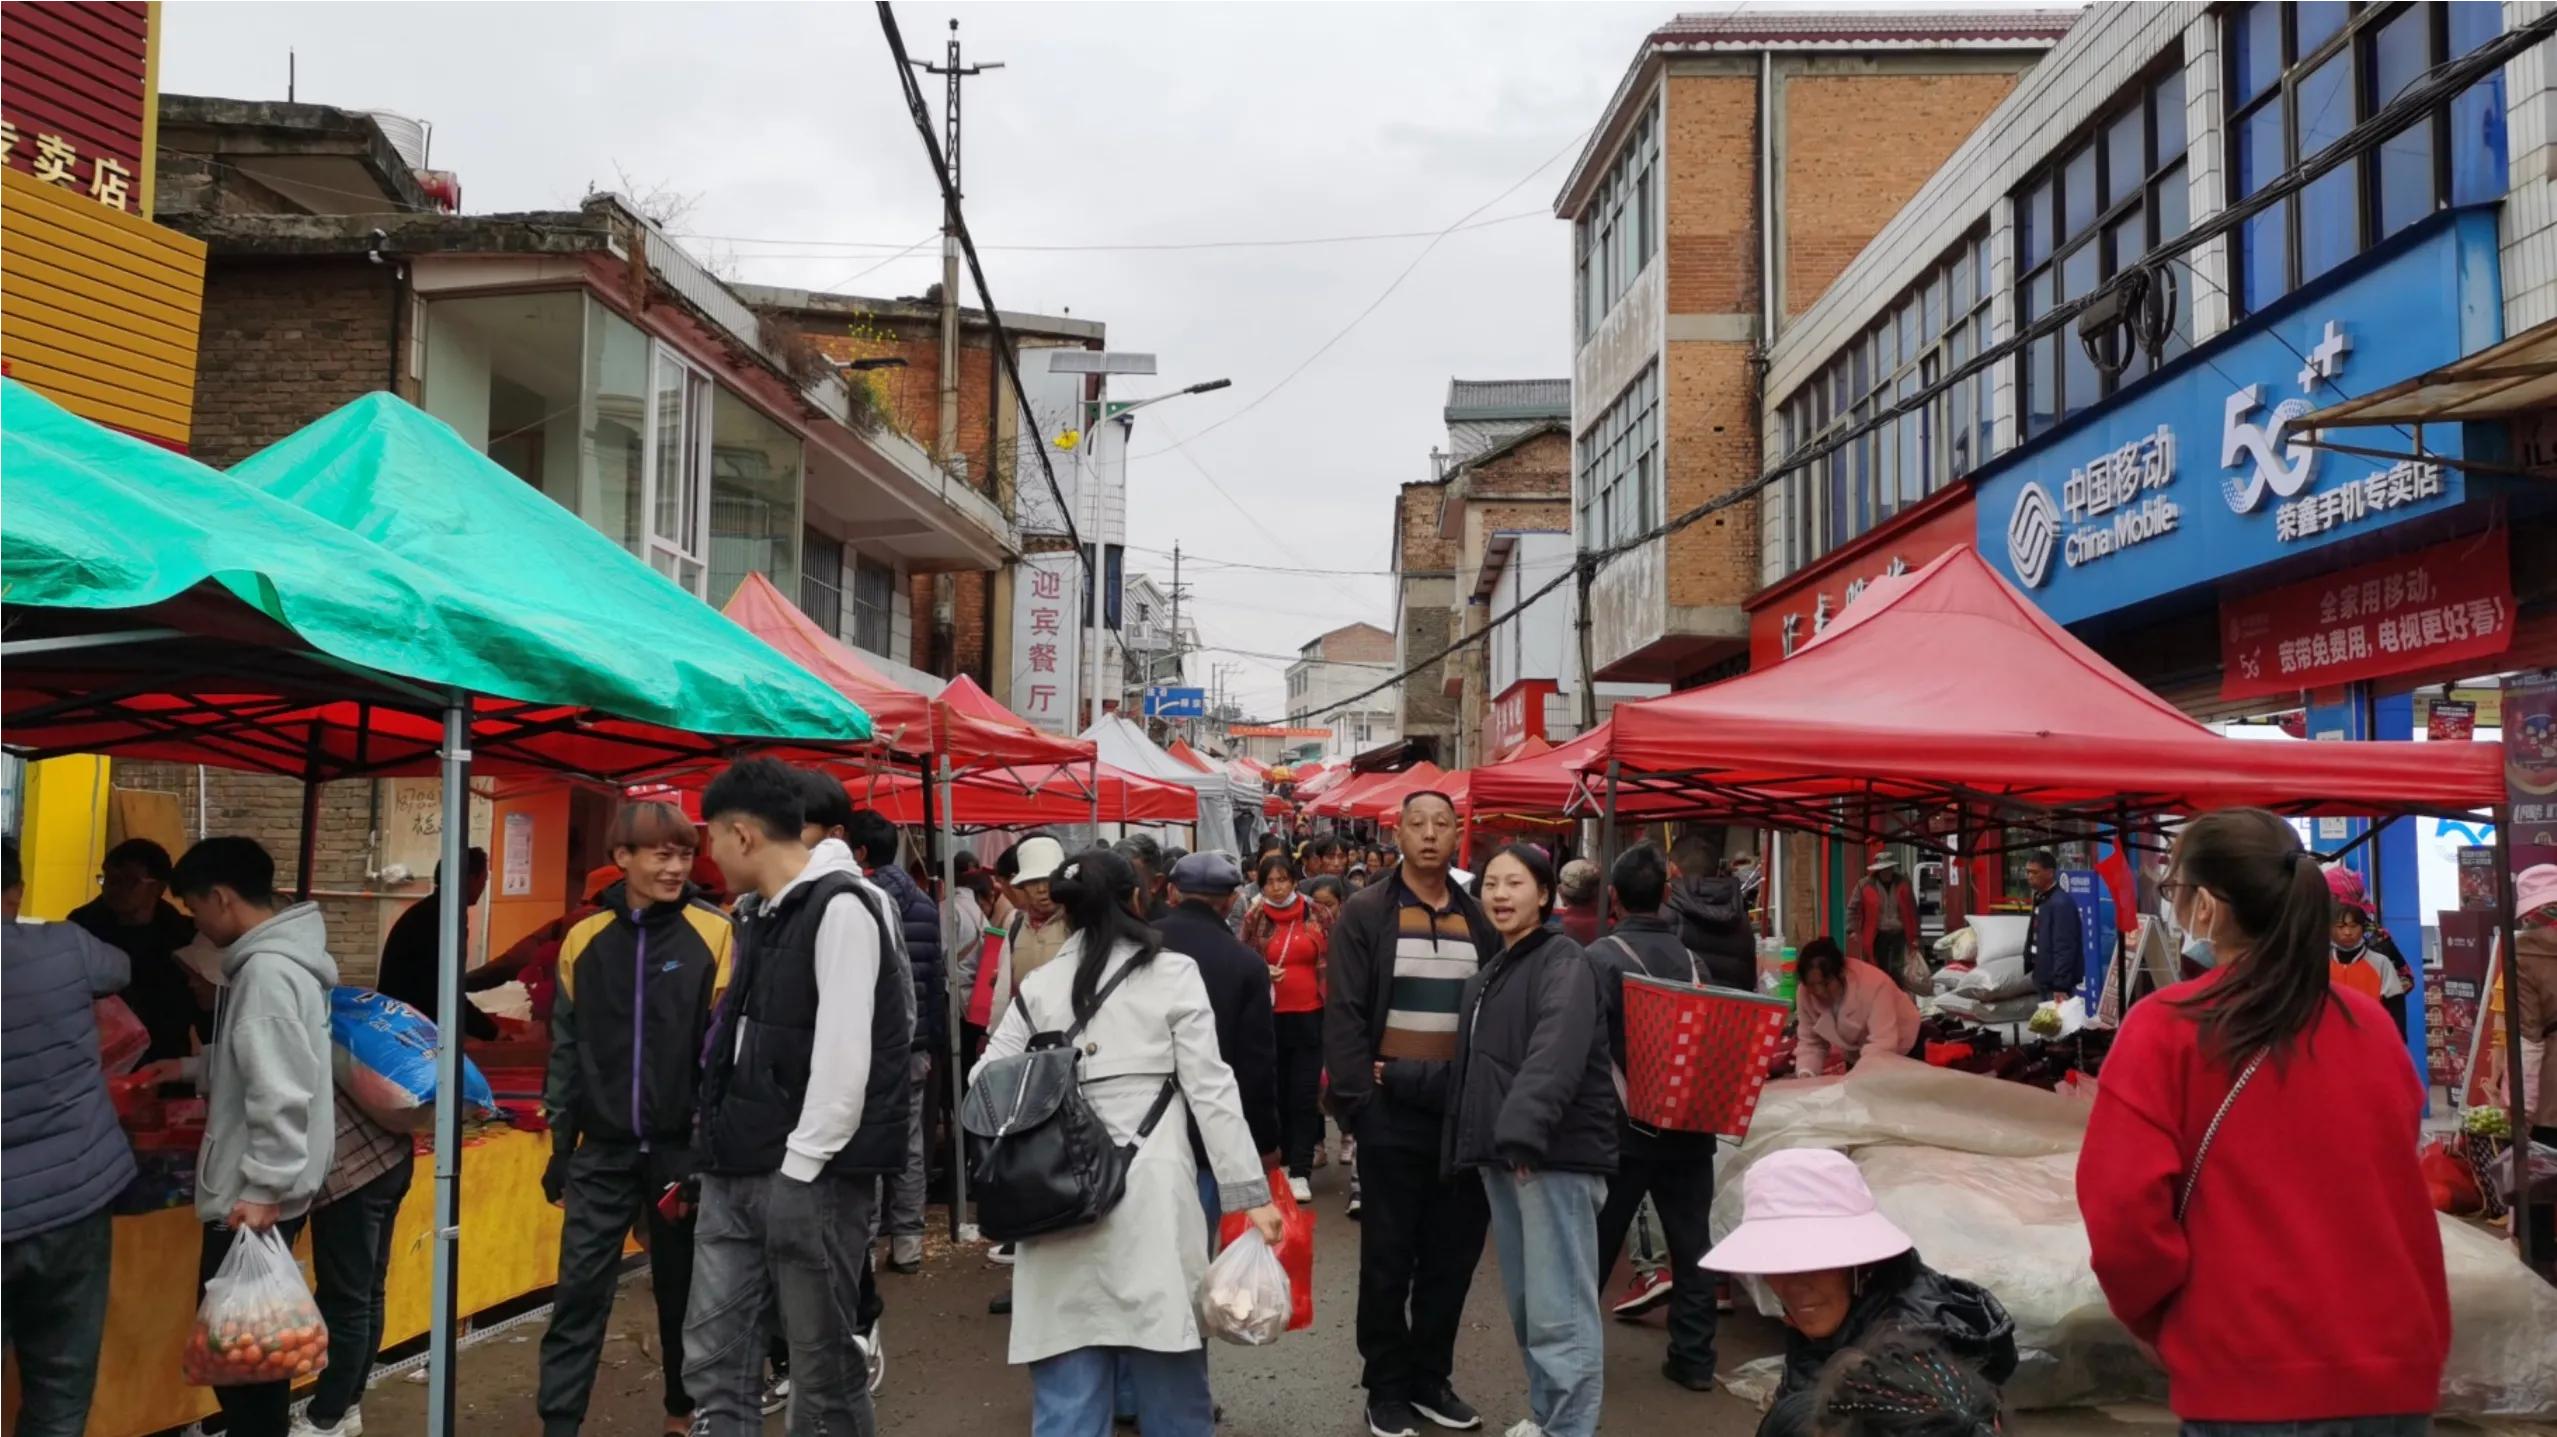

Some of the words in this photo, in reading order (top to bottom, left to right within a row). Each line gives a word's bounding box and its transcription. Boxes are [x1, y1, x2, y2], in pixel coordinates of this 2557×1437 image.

[2064, 424, 2176, 524] 中国移动
[2276, 459, 2441, 543] 荣鑫手机专卖店
[2065, 526, 2114, 568] China
[2114, 495, 2179, 549] Mobile
[1027, 571, 1060, 712] 迎宾餐厅
